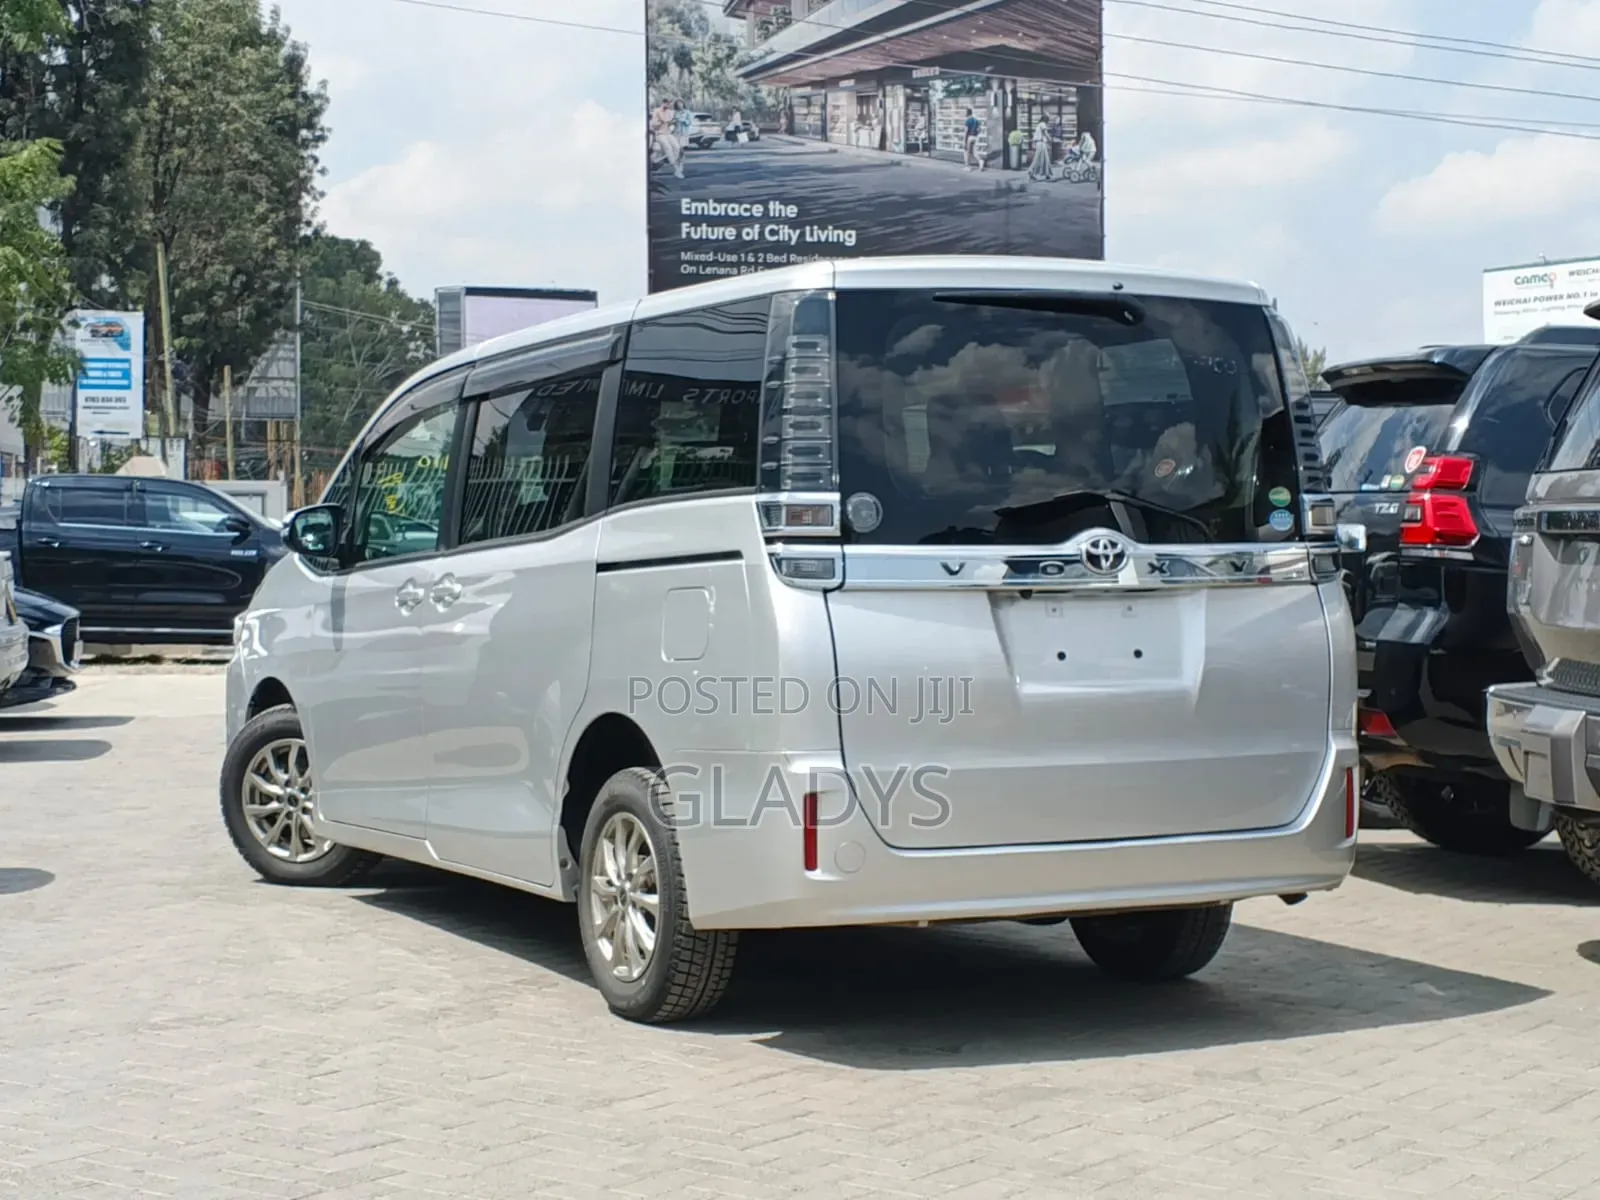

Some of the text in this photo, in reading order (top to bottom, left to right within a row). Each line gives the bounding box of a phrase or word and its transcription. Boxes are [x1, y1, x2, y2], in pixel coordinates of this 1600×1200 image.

[680, 198, 798, 217] Embrace the
[680, 222, 856, 246] Future of City Living
[681, 252, 738, 263] Mixed-Use
[740, 253, 745, 262] 1
[747, 253, 755, 263] &
[757, 253, 764, 262] 2
[767, 253, 787, 263] Bed
[681, 265, 697, 275] On
[699, 265, 738, 275] Lenana
[1533, 293, 1564, 304] POWER
